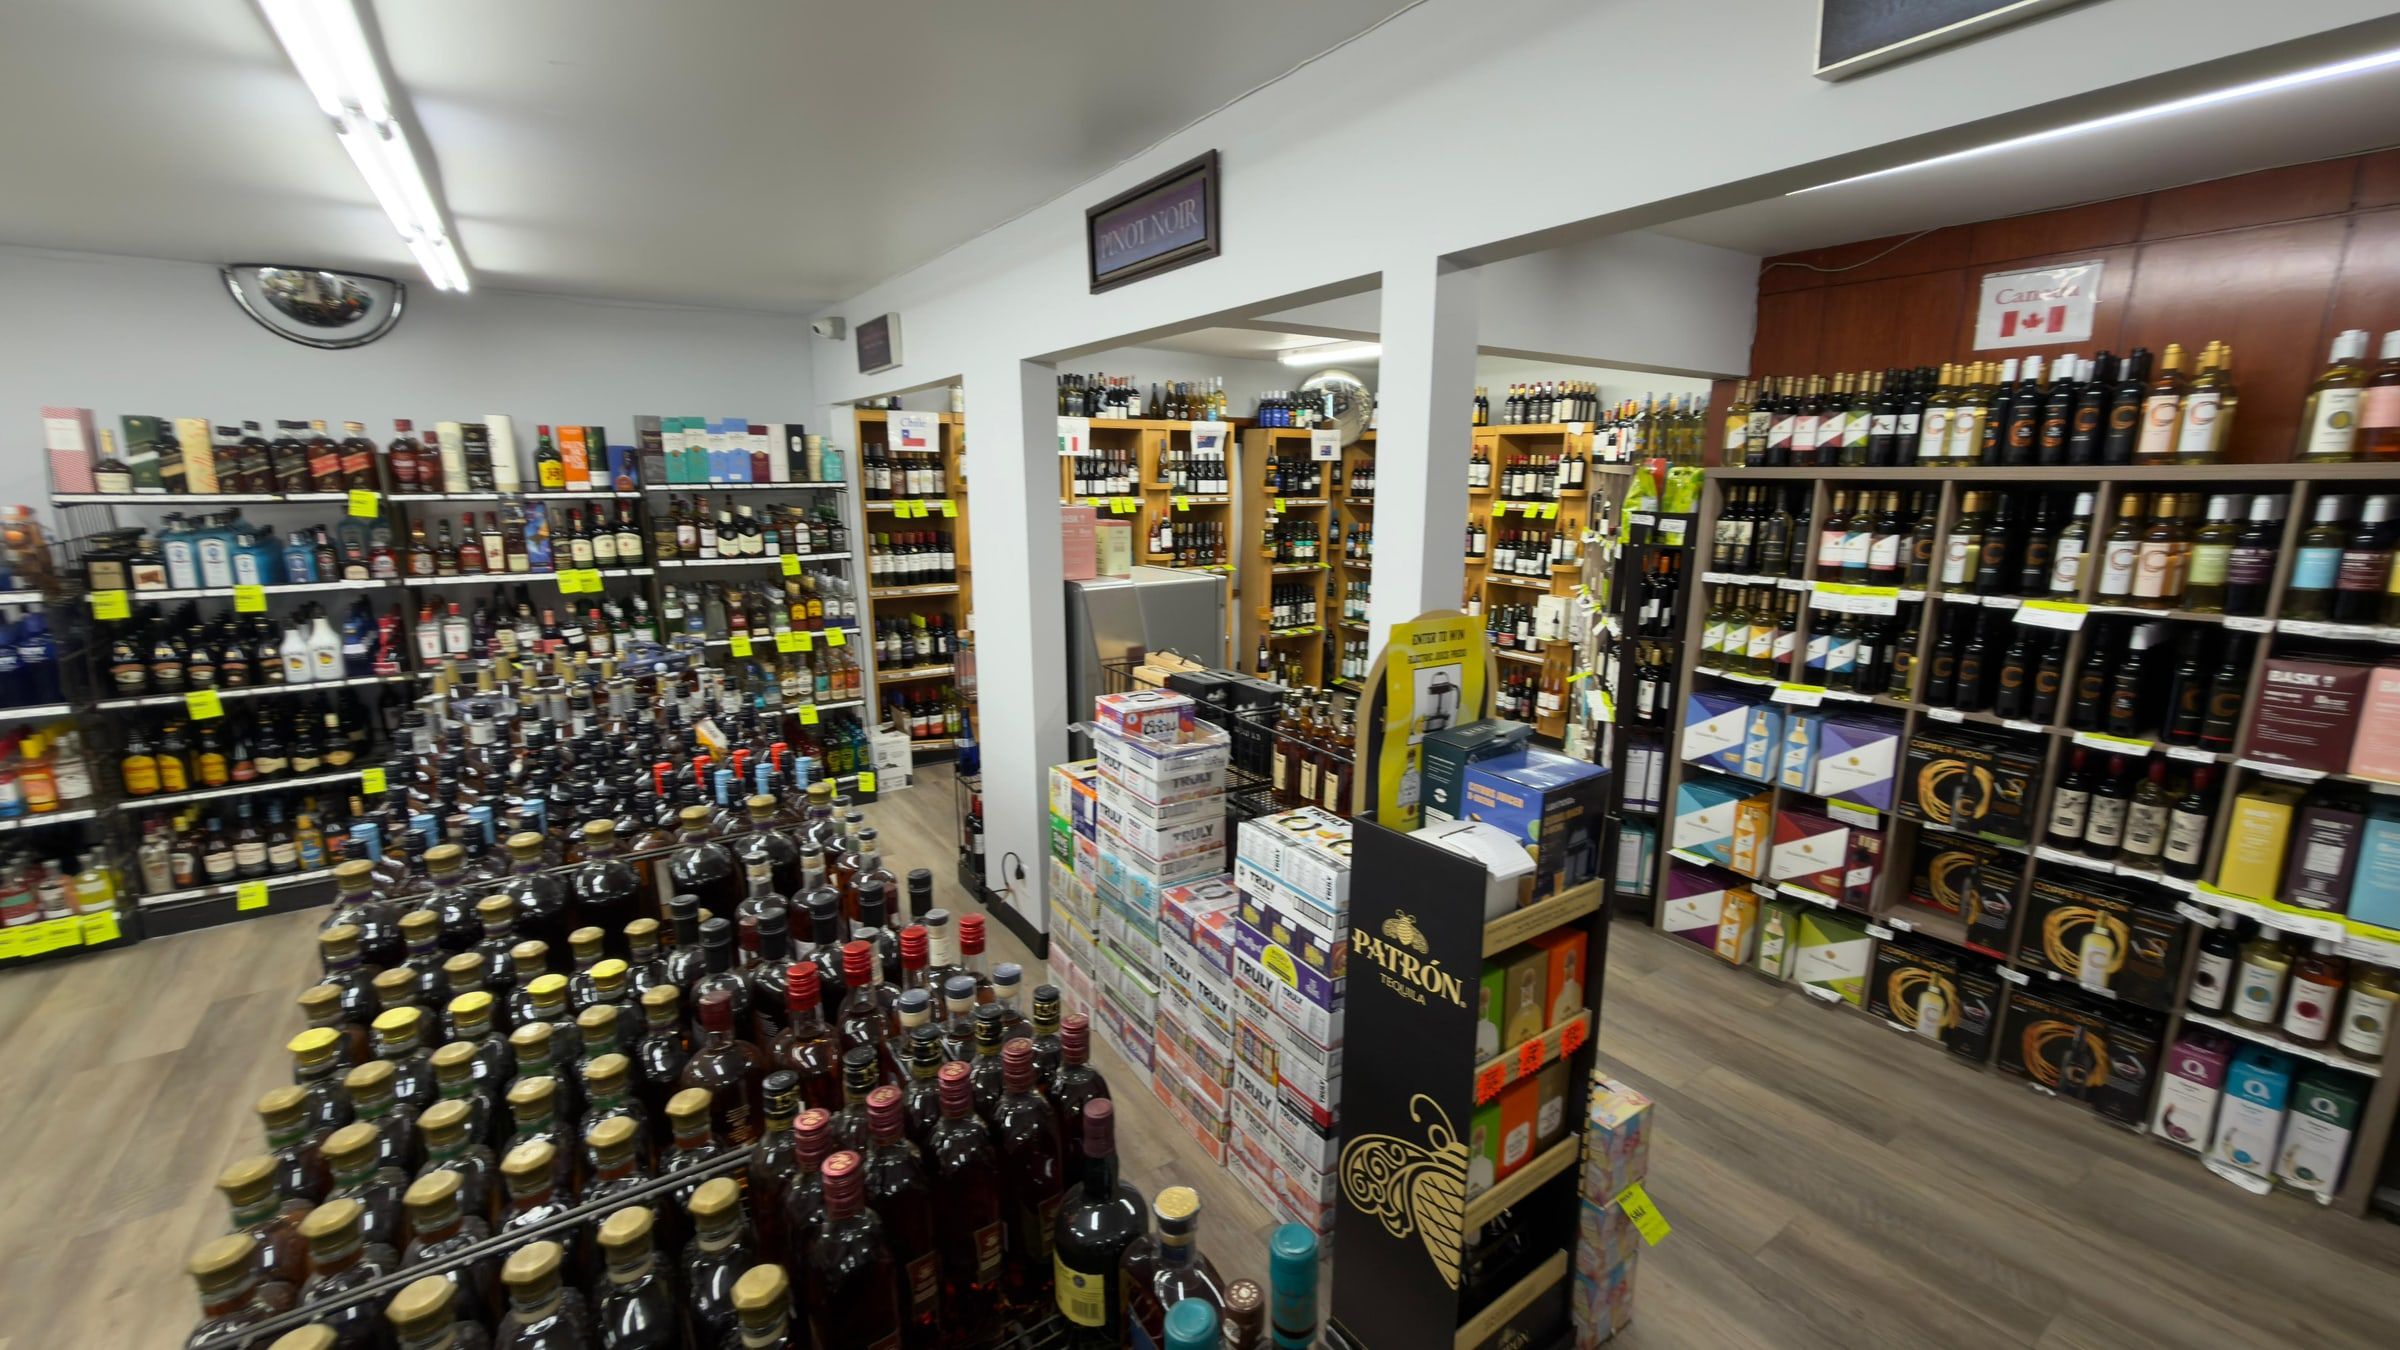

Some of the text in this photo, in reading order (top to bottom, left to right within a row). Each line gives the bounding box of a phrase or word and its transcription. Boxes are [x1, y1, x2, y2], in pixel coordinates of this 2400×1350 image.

[1099, 198, 1199, 259] PINOT NOIR
[1449, 629, 1466, 641] WIN
[1173, 771, 1213, 788] TRULY
[1173, 824, 1213, 842] TRULY
[1163, 952, 1192, 984] TRULY
[1237, 955, 1275, 991] TRULY
[1351, 928, 1464, 1006] PATRÓN
[1197, 979, 1228, 1011] TRULY
[1378, 972, 1428, 1007] TEQUILA
[1237, 1070, 1272, 1111] TRULY
